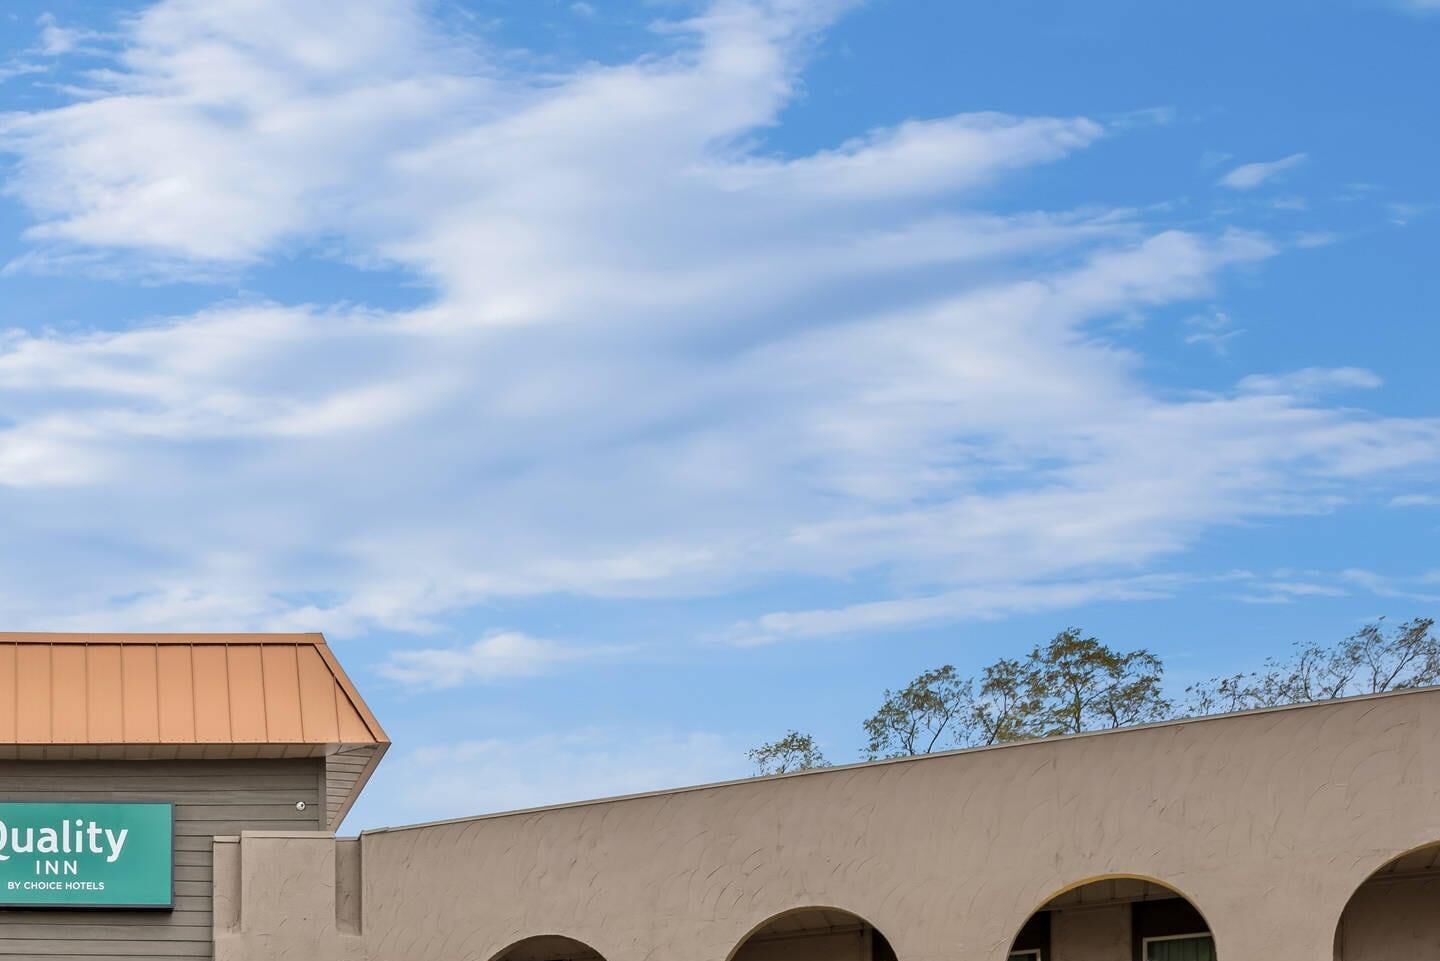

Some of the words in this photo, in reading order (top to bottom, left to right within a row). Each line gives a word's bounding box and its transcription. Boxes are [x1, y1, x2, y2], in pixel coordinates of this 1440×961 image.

[35, 860, 78, 875] INN
[7, 881, 22, 891] BY
[23, 881, 63, 891] CHOICE
[65, 881, 105, 891] HOTELS
